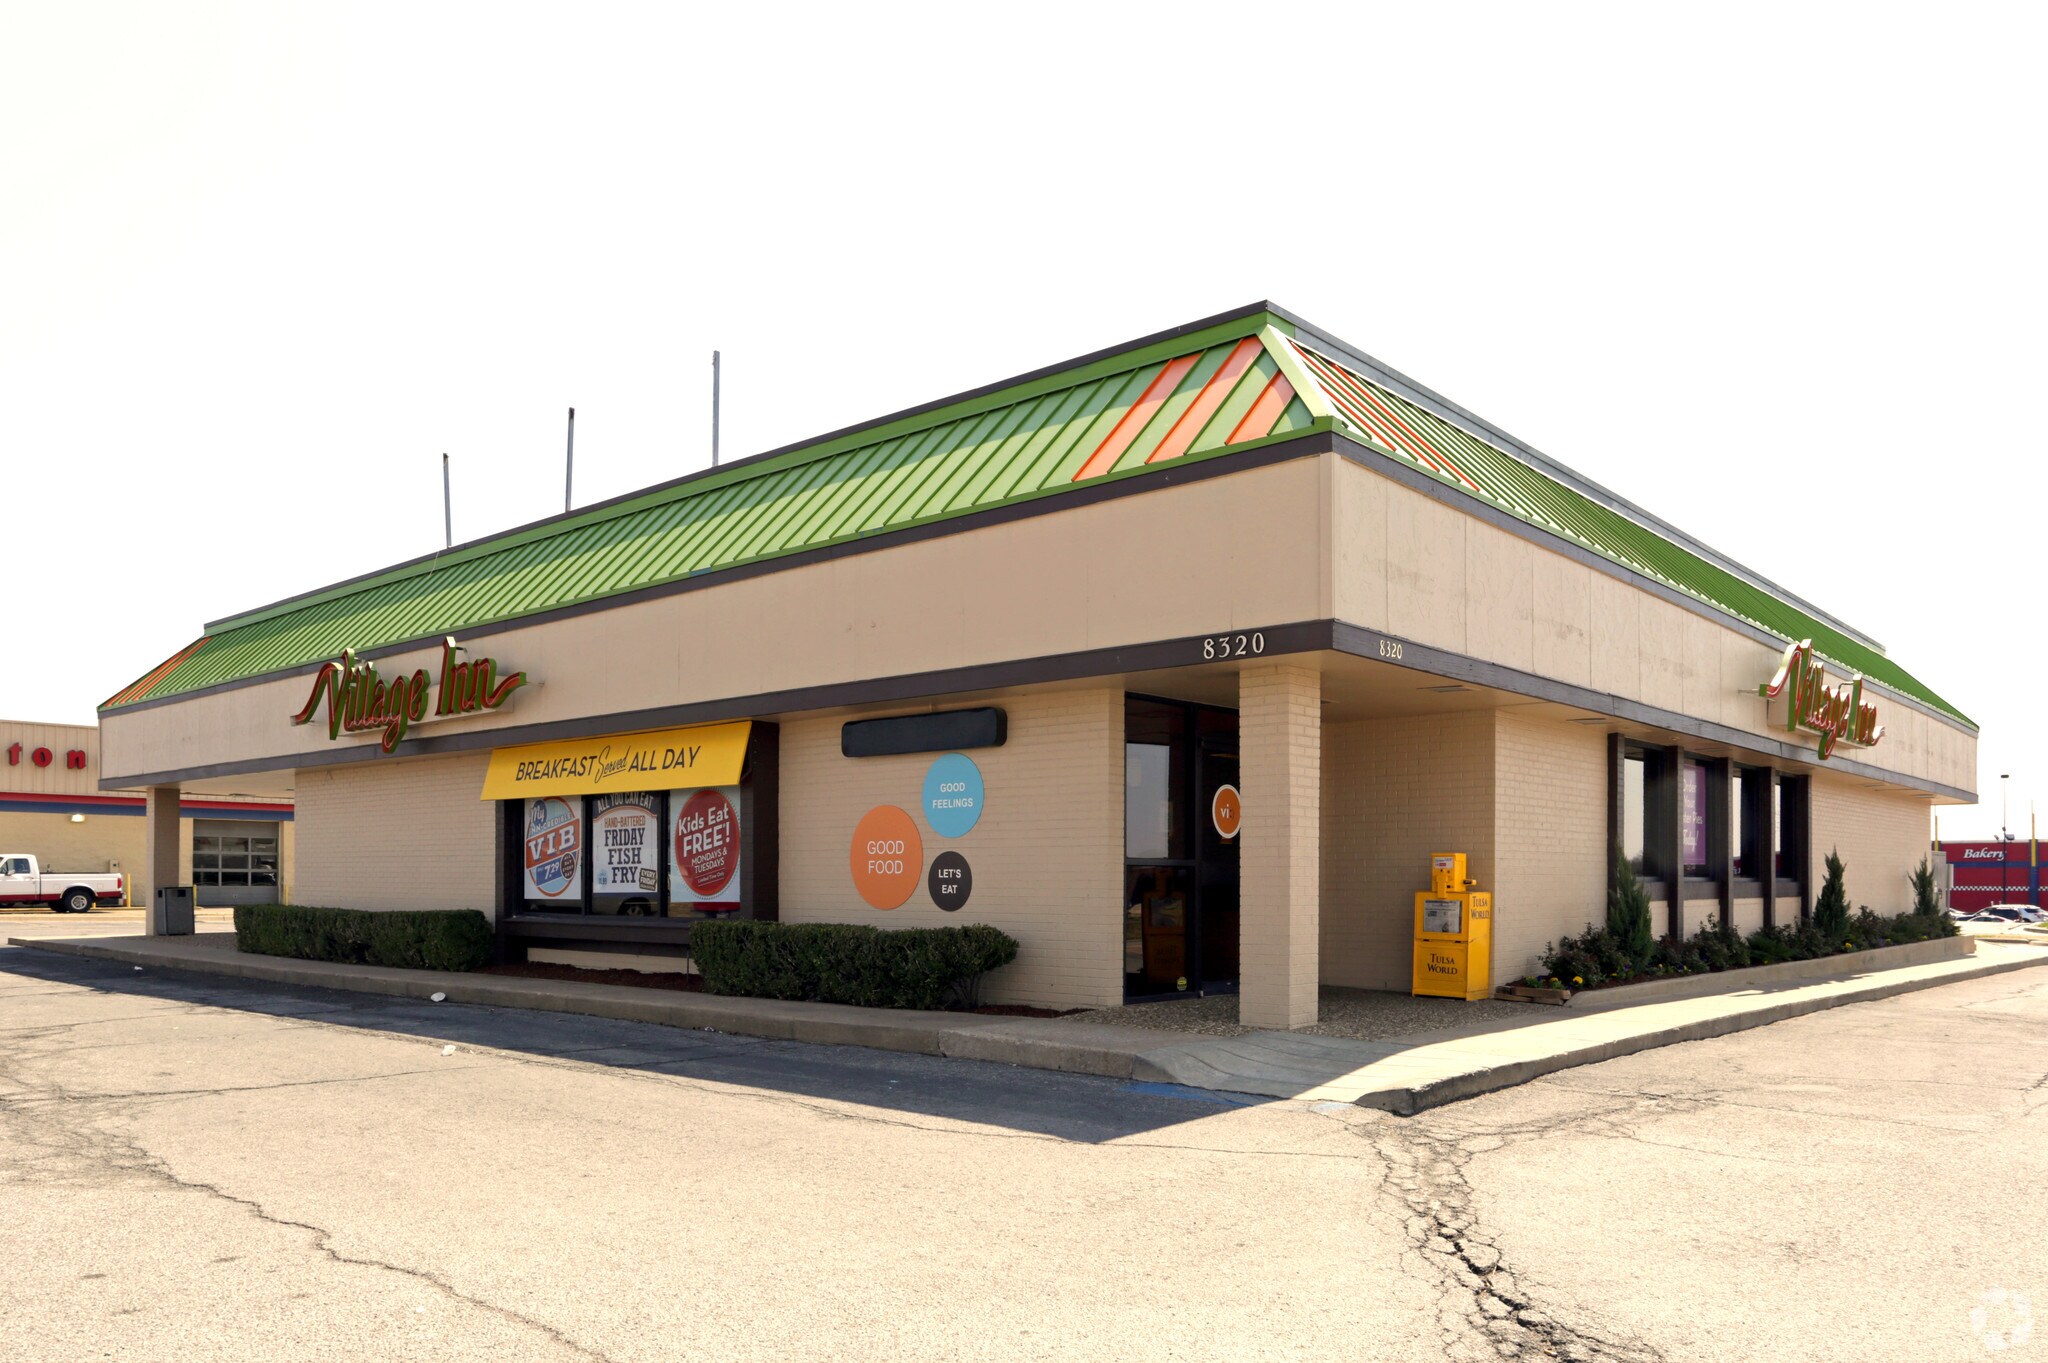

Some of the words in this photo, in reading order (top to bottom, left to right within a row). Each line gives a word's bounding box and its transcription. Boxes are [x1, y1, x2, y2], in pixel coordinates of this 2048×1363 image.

[1203, 631, 1266, 661] 8320
[1378, 639, 1403, 660] 8320
[290, 647, 432, 754] Village
[435, 635, 528, 717] Inn
[1759, 638, 1851, 760] Village
[1845, 673, 1886, 747] Inn
[515, 755, 598, 782] BREAKFAST
[594, 744, 632, 784] Served
[628, 749, 657, 773] ALL
[661, 745, 702, 770] DAY
[940, 782, 966, 793] GOOD
[597, 797, 610, 814] ALL
[610, 792, 624, 807] YOU
[625, 792, 639, 805] CAN
[639, 792, 655, 810] EAT
[932, 797, 974, 809] FEELINGS
[530, 804, 545, 823] My
[678, 812, 705, 837] Kids
[708, 803, 729, 826] Eat
[604, 827, 646, 847] FRIDAY
[607, 847, 642, 865] FISH
[691, 848, 722, 866] MONDAYS
[722, 846, 728, 857] &
[867, 840, 905, 856] GOOD
[1963, 846, 2006, 861] Bakery
[694, 857, 725, 874] TUESDAYS
[867, 859, 904, 875] FOOD
[938, 868, 962, 879] LET'S
[611, 866, 638, 884] FRY
[941, 884, 958, 895] EAT
[1430, 953, 1455, 965] TULSA
[1427, 963, 1458, 975] WORLD
